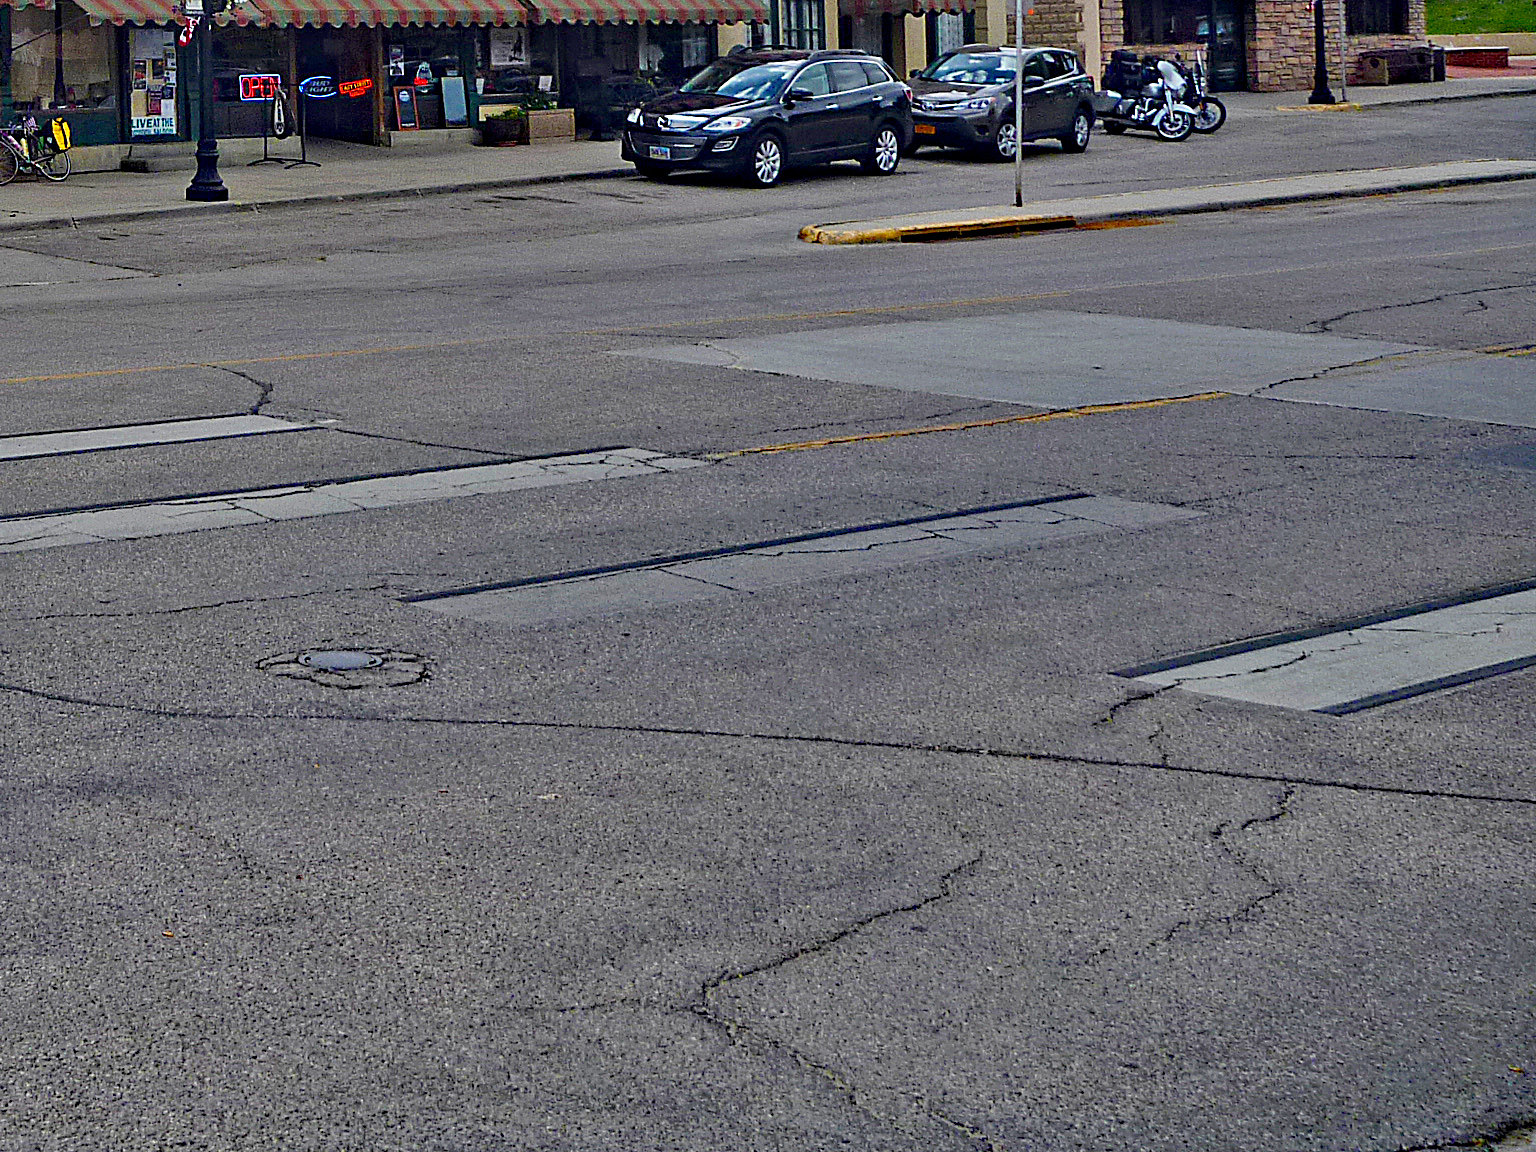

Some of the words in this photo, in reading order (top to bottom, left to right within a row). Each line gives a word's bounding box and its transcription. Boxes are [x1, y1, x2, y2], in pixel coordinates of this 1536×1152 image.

[241, 76, 280, 98] OPEN
[131, 119, 152, 128] LIVE
[154, 118, 160, 127] AT
[161, 117, 174, 127] THE
